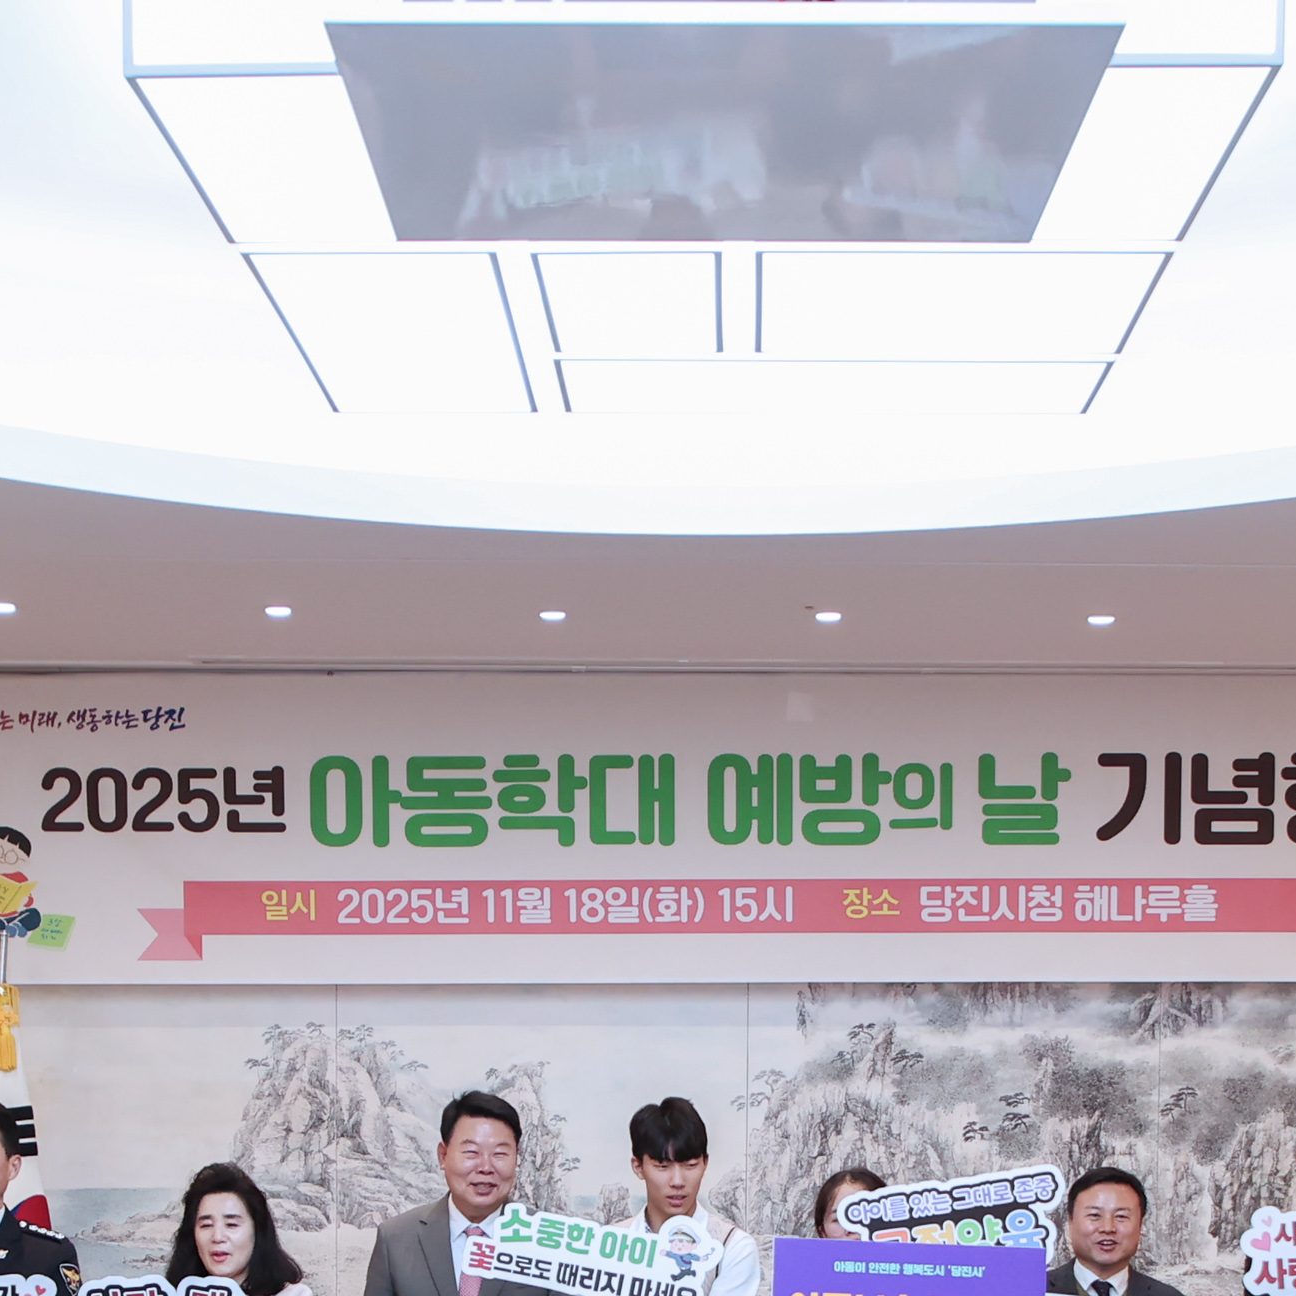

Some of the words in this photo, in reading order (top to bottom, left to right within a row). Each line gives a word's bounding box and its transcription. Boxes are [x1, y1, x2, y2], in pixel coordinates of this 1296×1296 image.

[18, 710, 62, 733] 미래,
[66, 708, 139, 733] 생동하는
[141, 706, 186, 731] 당진
[40, 765, 287, 834] 2025년
[309, 753, 675, 848] 아동학대
[707, 752, 954, 847] 예방의
[977, 751, 1072, 846] 날
[260, 890, 317, 922] 일시
[336, 888, 469, 926] 2025년
[483, 887, 552, 925] 11월
[566, 886, 704, 926] 18일(화)
[719, 884, 794, 923] 15시
[842, 888, 899, 920] 장소
[919, 884, 1065, 923] 당진시청
[1073, 883, 1219, 923] 해나루홀
[848, 1196, 907, 1223] 아이를
[909, 1190, 952, 1218] 있는
[953, 1182, 1011, 1210] 그대로
[1013, 1174, 1056, 1201] 존중
[500, 1208, 595, 1255] 소중한
[599, 1231, 658, 1268] 아이
[468, 1242, 553, 1282] 꽃으로도
[556, 1261, 625, 1296] 때리지
[834, 1261, 866, 1274] 아동이
[869, 1262, 901, 1275] 안전한
[903, 1263, 945, 1276] 행복도시
